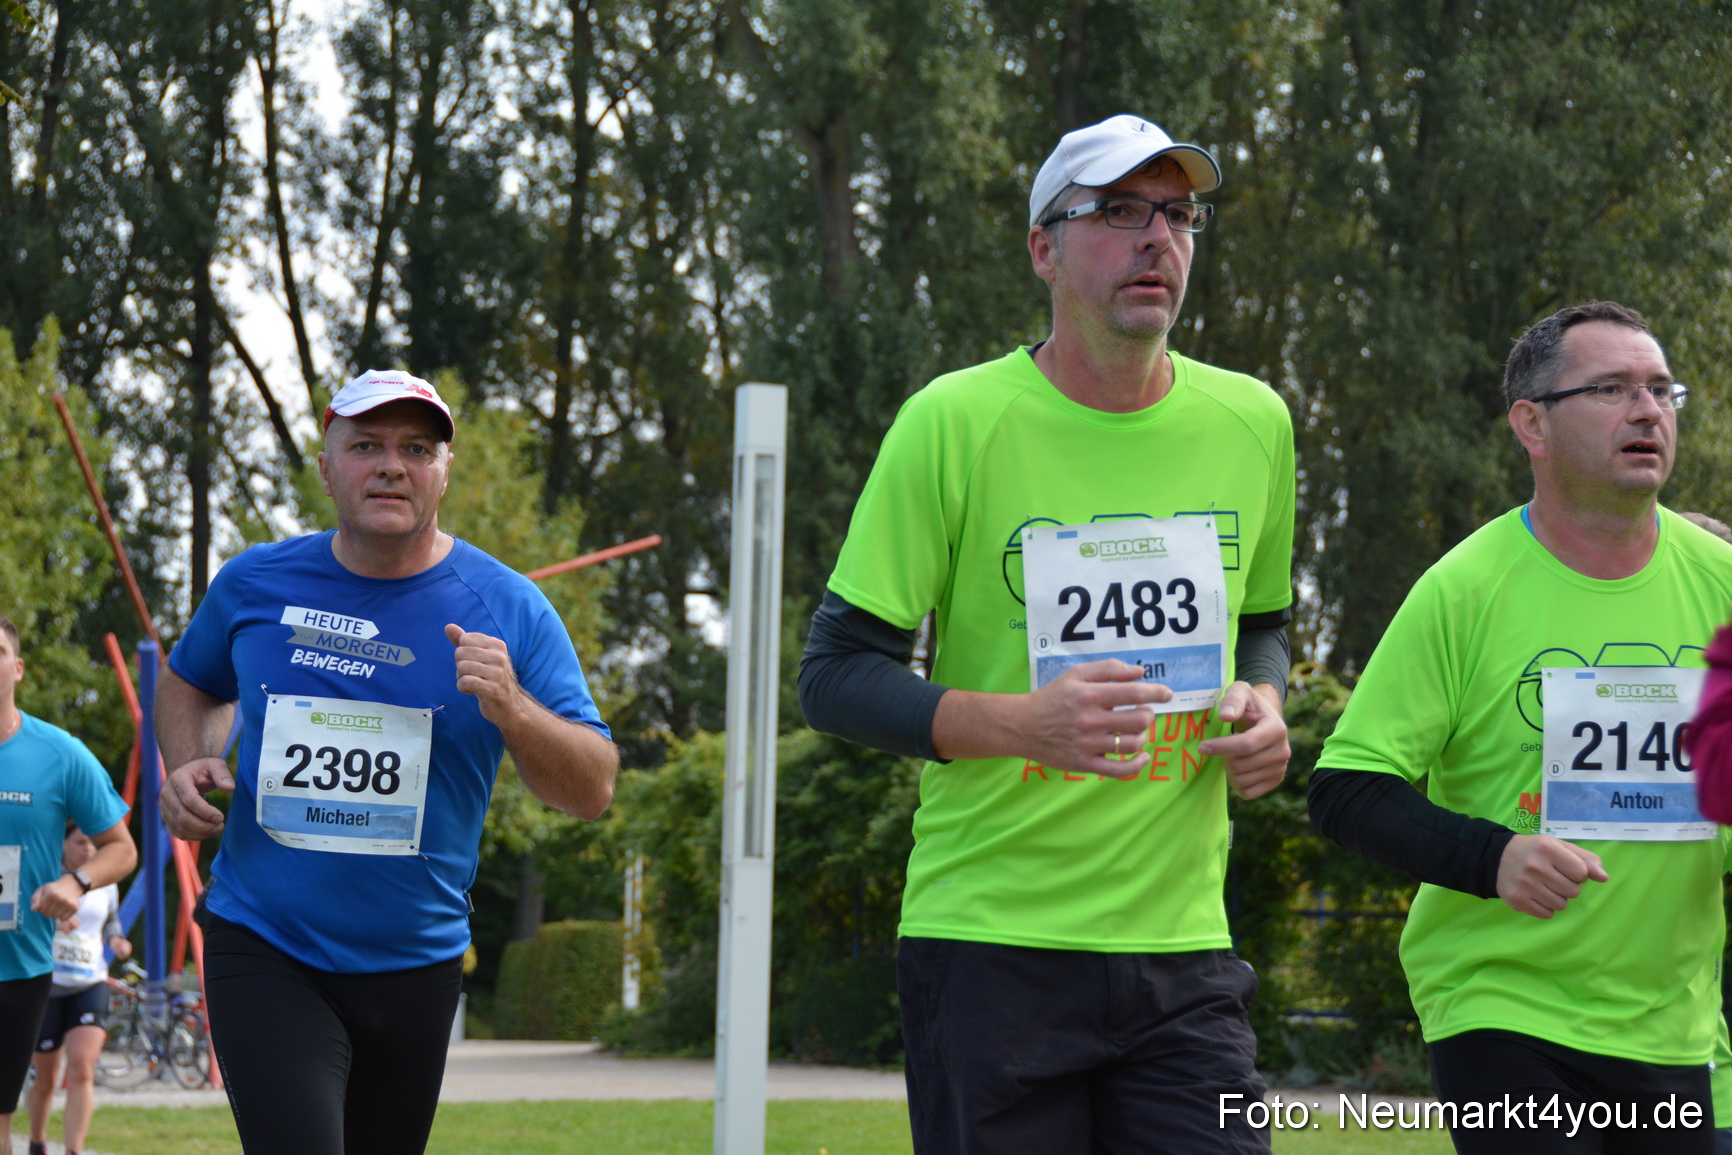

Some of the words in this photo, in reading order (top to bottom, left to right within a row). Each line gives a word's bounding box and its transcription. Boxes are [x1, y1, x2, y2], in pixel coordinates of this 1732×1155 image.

[1100, 537, 1167, 557] BOCK
[1057, 578, 1200, 643] 2483
[303, 611, 364, 635] HEUTE
[316, 632, 401, 662] MORGEN
[1040, 637, 1048, 649] D
[290, 648, 376, 679] BEWEGEN
[1614, 684, 1678, 698] BOCK
[327, 713, 383, 729] BOCK
[283, 743, 402, 796] 2398
[1552, 764, 1559, 774] D
[266, 780, 273, 790] C
[1610, 791, 1664, 810] Anton
[306, 806, 371, 827] Michael
